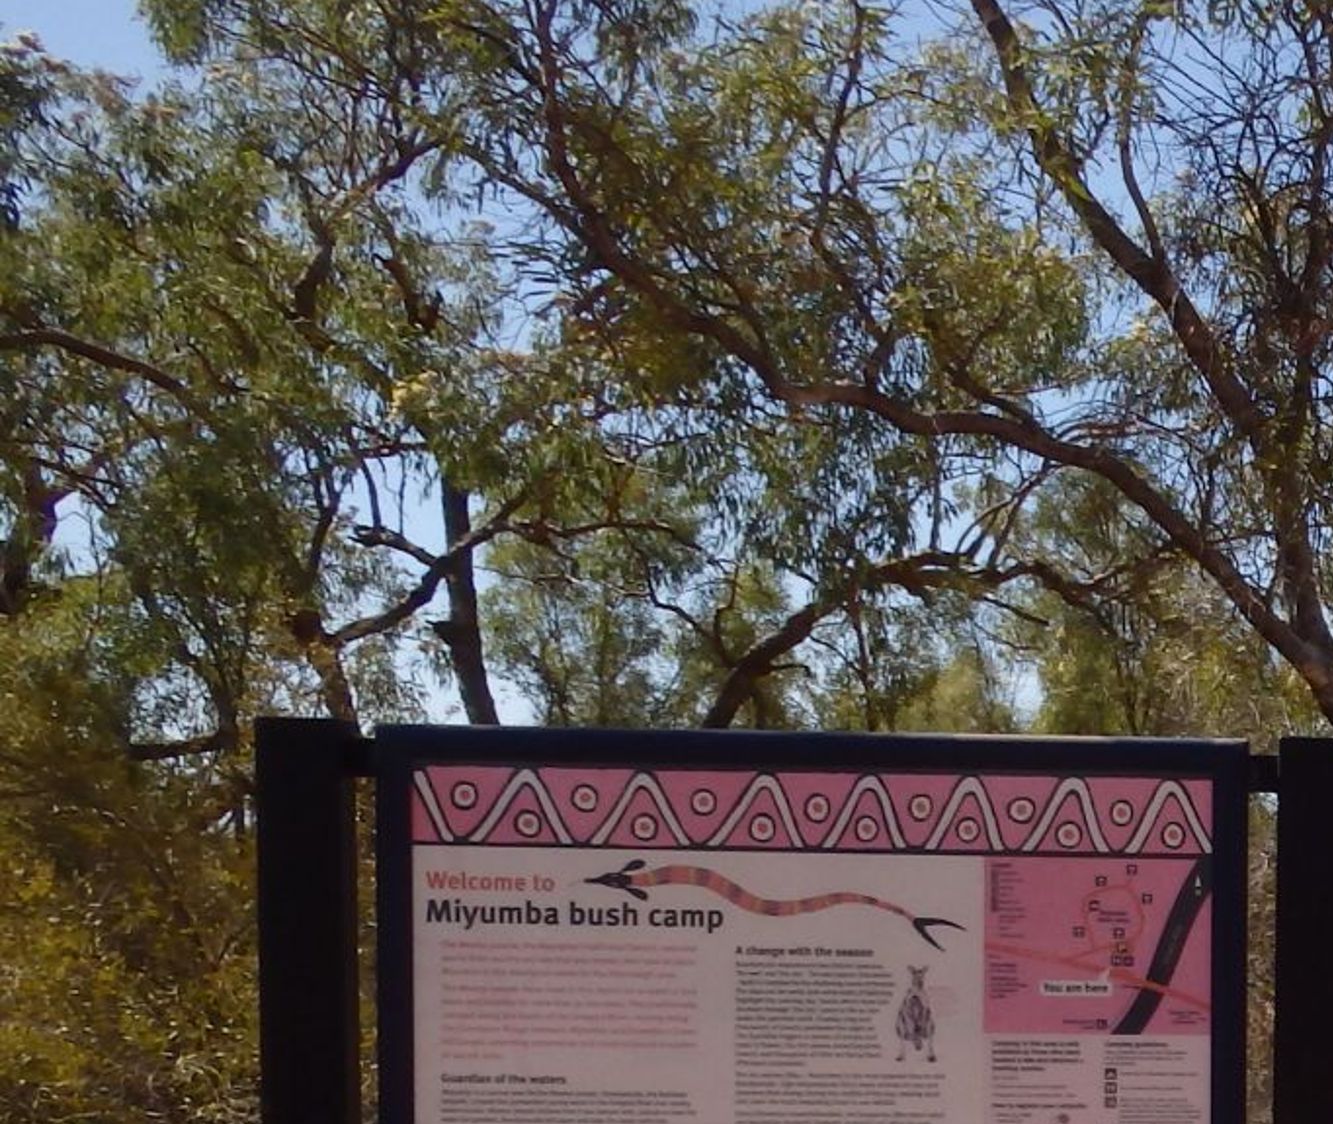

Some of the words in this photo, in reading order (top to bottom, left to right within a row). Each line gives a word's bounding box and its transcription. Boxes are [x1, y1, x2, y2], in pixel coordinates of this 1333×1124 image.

[426, 870, 526, 892] Welcome
[533, 872, 555, 892] to
[426, 899, 558, 931] Miyumba
[570, 901, 638, 927] bush
[649, 906, 724, 934] camp
[788, 946, 812, 957] with
[815, 946, 833, 957] the
[494, 1074, 506, 1085] of
[508, 1074, 527, 1085] the
